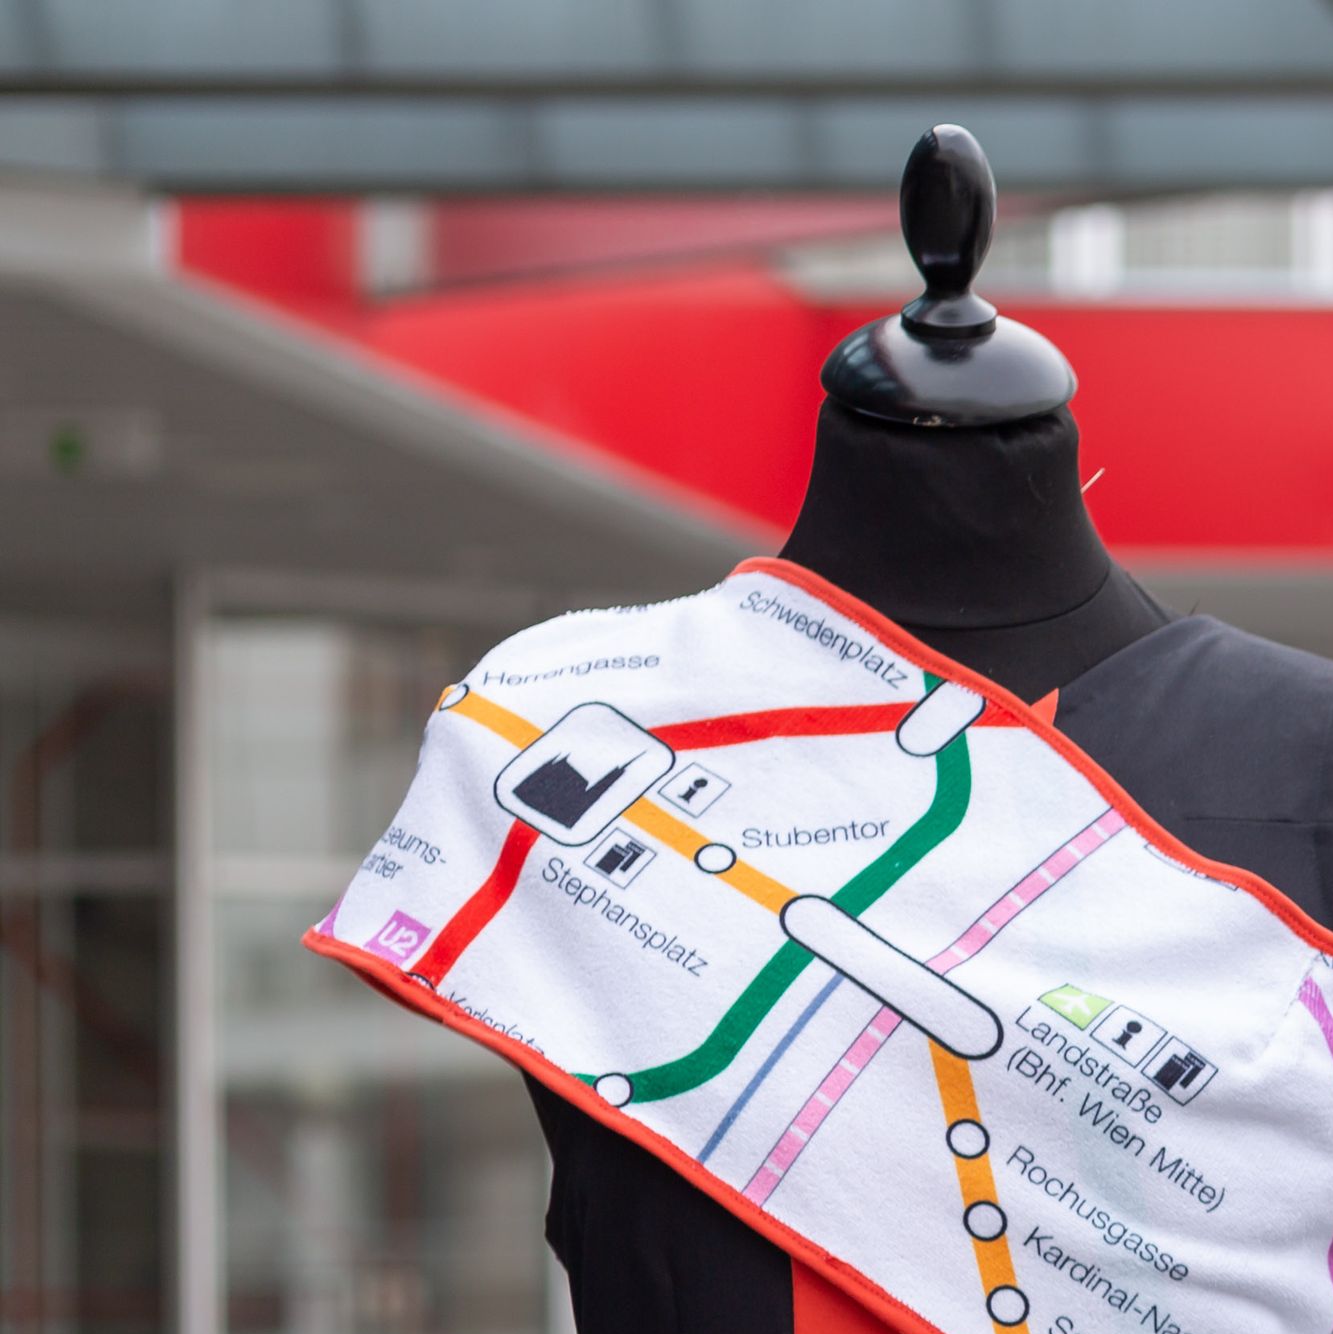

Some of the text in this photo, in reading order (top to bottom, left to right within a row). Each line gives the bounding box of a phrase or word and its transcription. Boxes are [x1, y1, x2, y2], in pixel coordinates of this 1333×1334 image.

[483, 655, 660, 686] Herrengasse
[739, 589, 909, 689] Schwedenplatz
[741, 816, 891, 849] Stubentor
[377, 920, 419, 958] U2
[541, 856, 709, 978] Stephansplatz
[1015, 1005, 1162, 1124] Landstraße
[1006, 1046, 1225, 1213] (Bhf. Wien Mitte)
[1006, 1145, 1189, 1282] Rochusgasse
